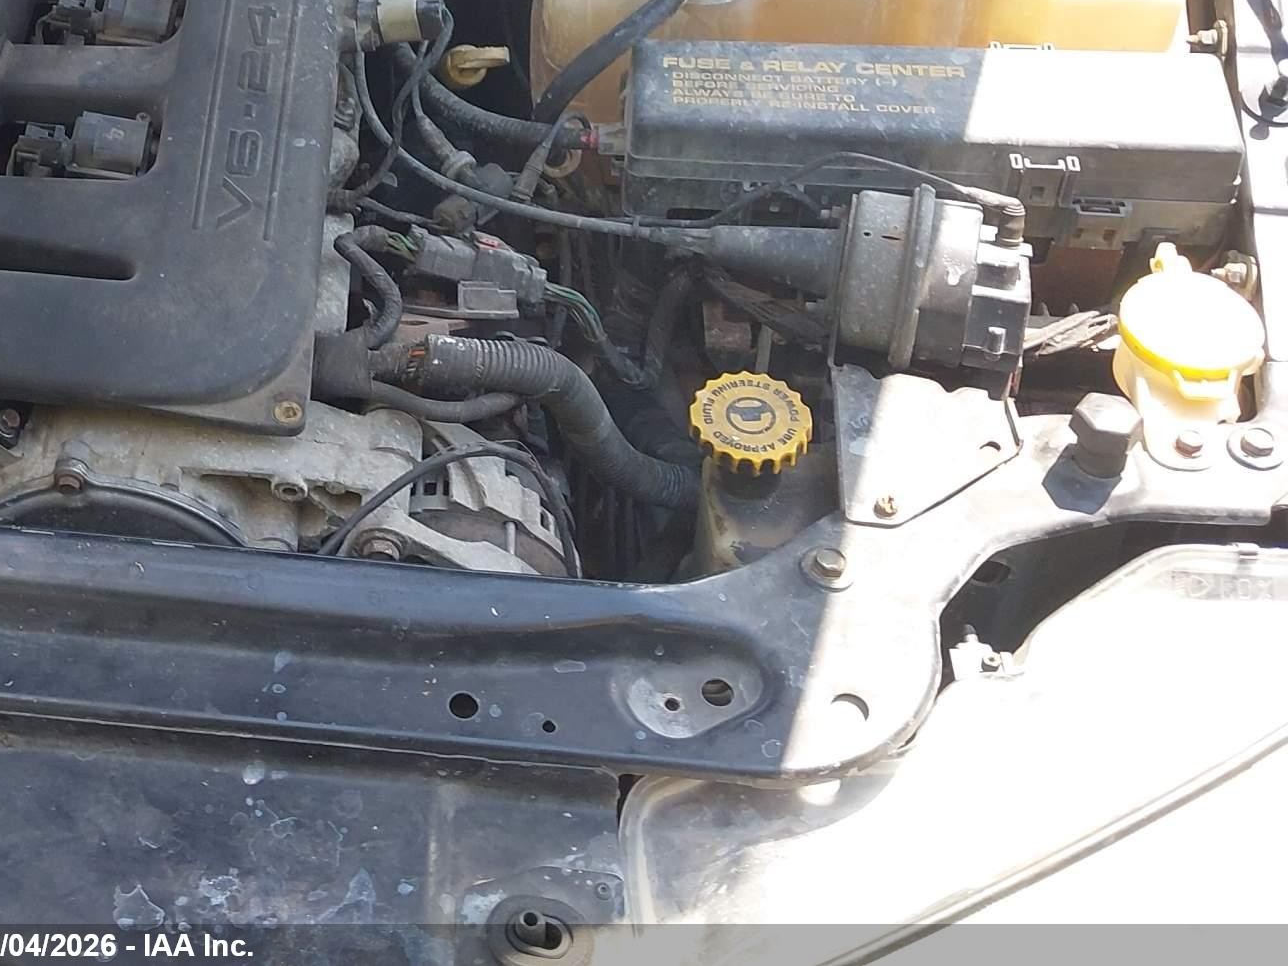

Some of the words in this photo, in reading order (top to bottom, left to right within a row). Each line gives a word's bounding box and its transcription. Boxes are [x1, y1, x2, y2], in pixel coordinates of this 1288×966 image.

[662, 56, 731, 71] FUSE
[739, 59, 755, 71] &
[763, 60, 847, 75] RELAY
[856, 63, 967, 79] CENTER
[672, 79, 737, 90] BEFORE
[790, 76, 874, 86] BATTERY
[672, 88, 744, 99] ALWAYS
[783, 92, 826, 102] SURE
[833, 94, 855, 103] TO
[672, 96, 760, 107] PROPERLY
[877, 105, 936, 114] COVER
[711, 379, 771, 398] STEERING
[702, 397, 715, 425] FLUID
[773, 388, 800, 423] POWER
[713, 431, 776, 453] APPROVED
[777, 428, 798, 446] USE
